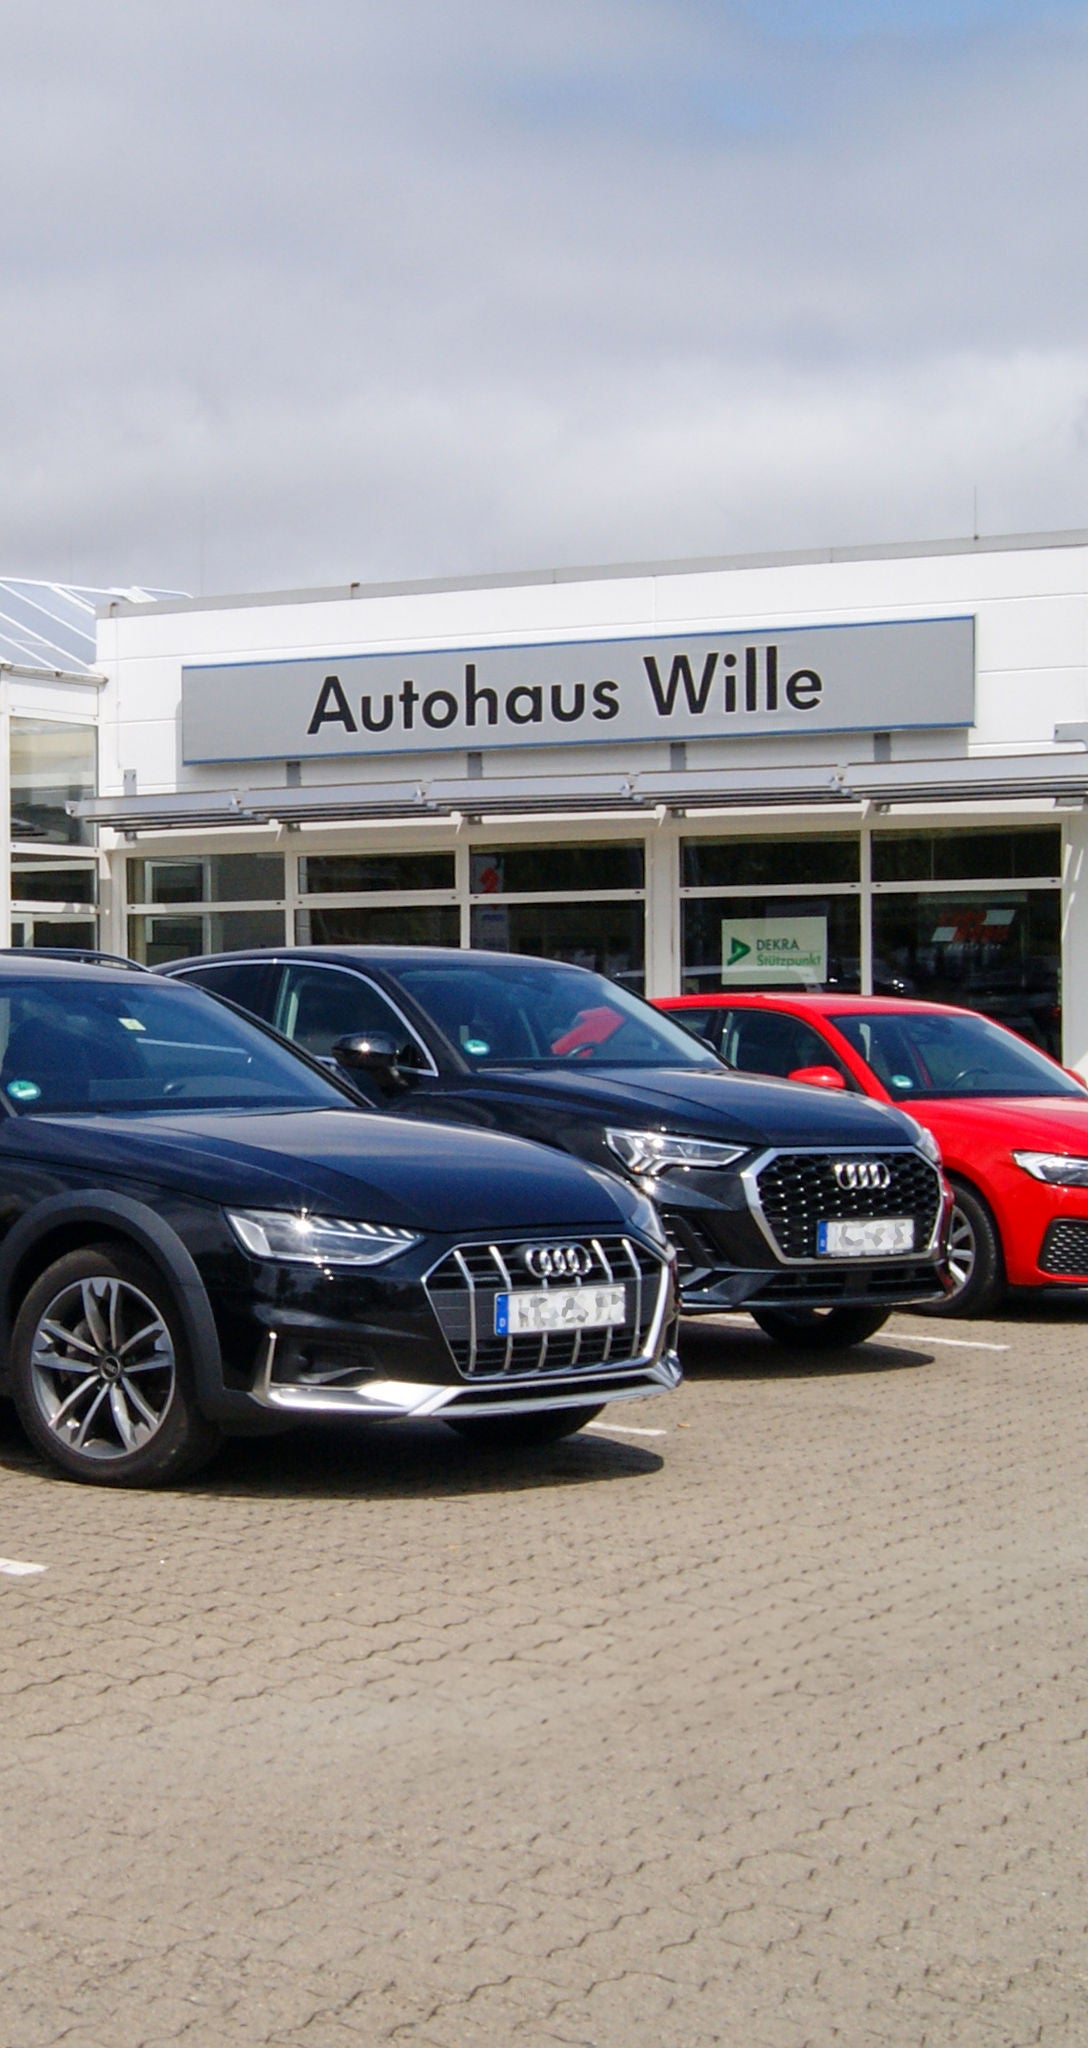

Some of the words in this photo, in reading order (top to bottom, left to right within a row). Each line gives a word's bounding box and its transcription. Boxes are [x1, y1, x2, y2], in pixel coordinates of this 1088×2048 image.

[308, 664, 620, 735] Autohaus
[643, 645, 823, 716] Wille
[756, 938, 800, 951] DEKRA
[756, 953, 822, 969] Stützpunkt
